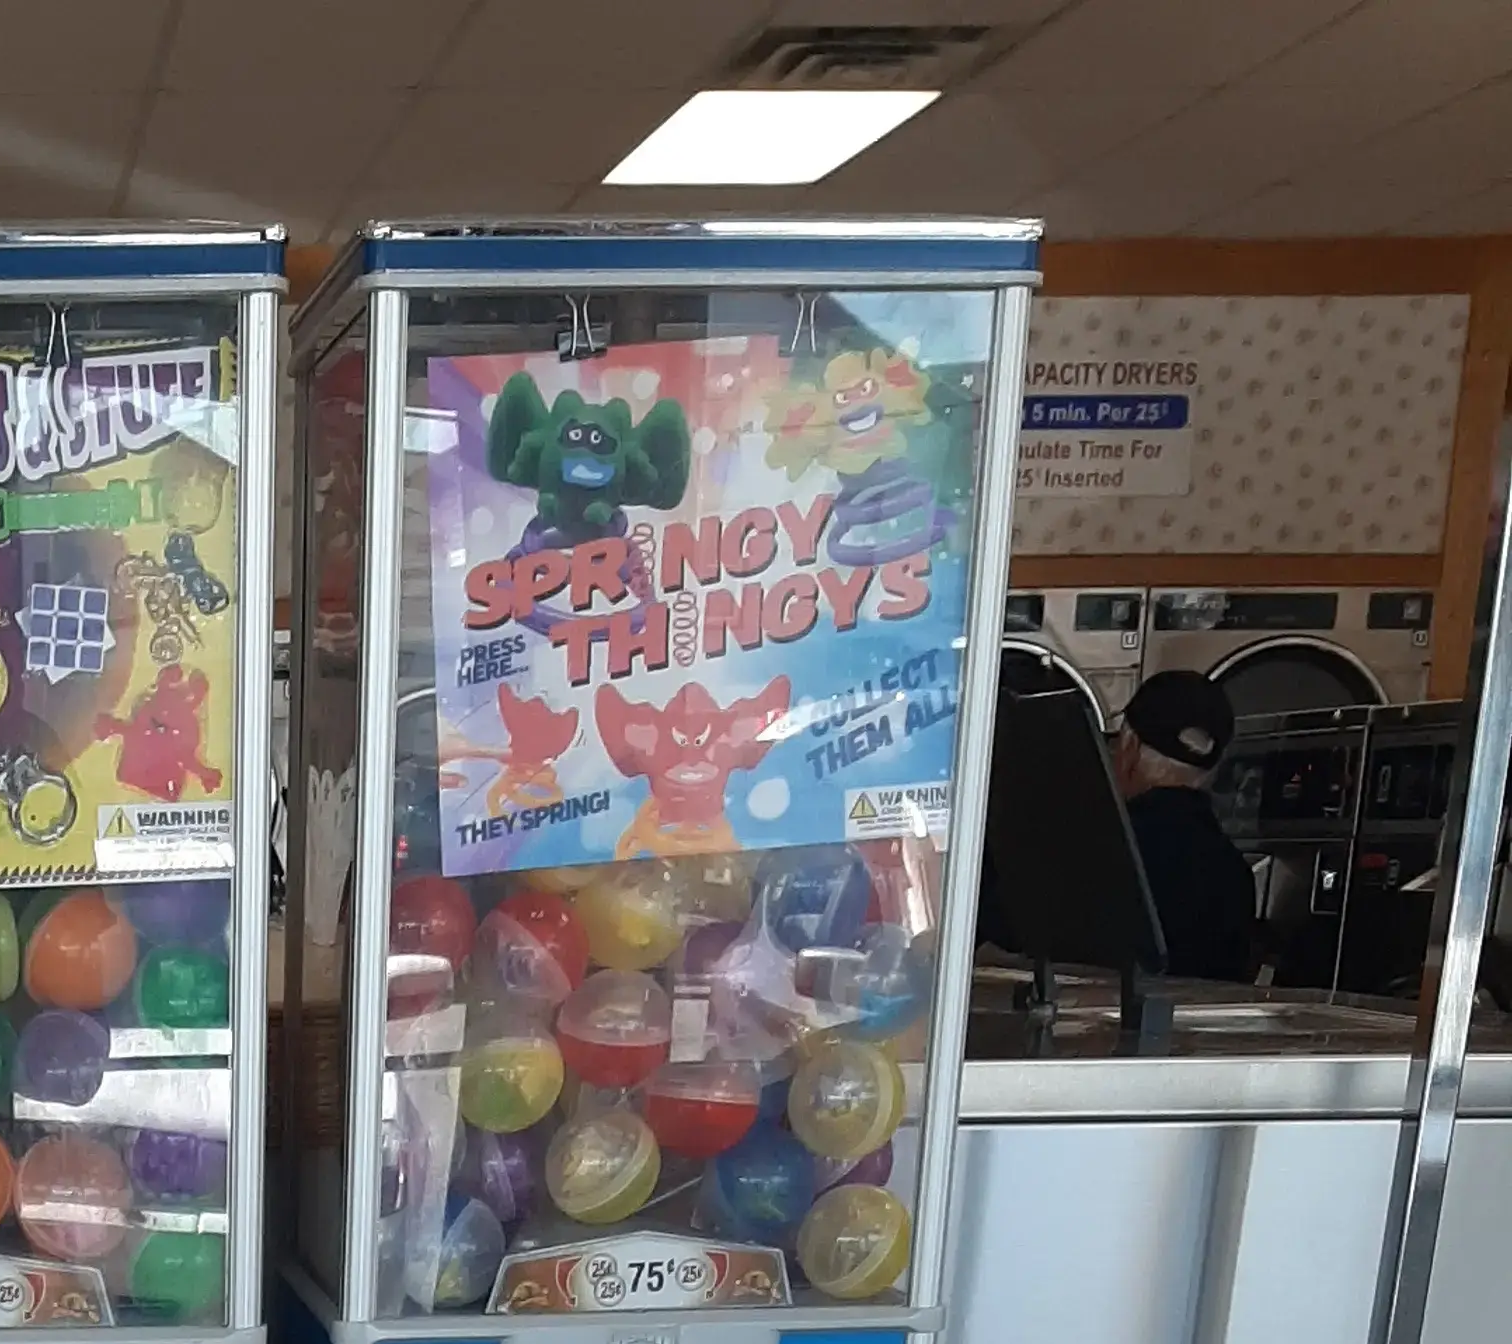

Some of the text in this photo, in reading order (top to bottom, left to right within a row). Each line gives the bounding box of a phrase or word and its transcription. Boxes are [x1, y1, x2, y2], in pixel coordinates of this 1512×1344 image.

[1112, 361, 1198, 387] DRYERS
[1049, 400, 1091, 422] min.
[1097, 401, 1131, 421] Per
[1079, 440, 1124, 460] Time
[1131, 439, 1164, 459] For
[1044, 467, 1125, 488] Inserted
[460, 633, 526, 665] PRESS
[809, 647, 943, 738] COLLECT
[804, 713, 894, 781] THEM
[136, 808, 230, 827] WARNING
[454, 789, 611, 846] THEY SPRING!
[627, 1257, 676, 1294] 75¢
